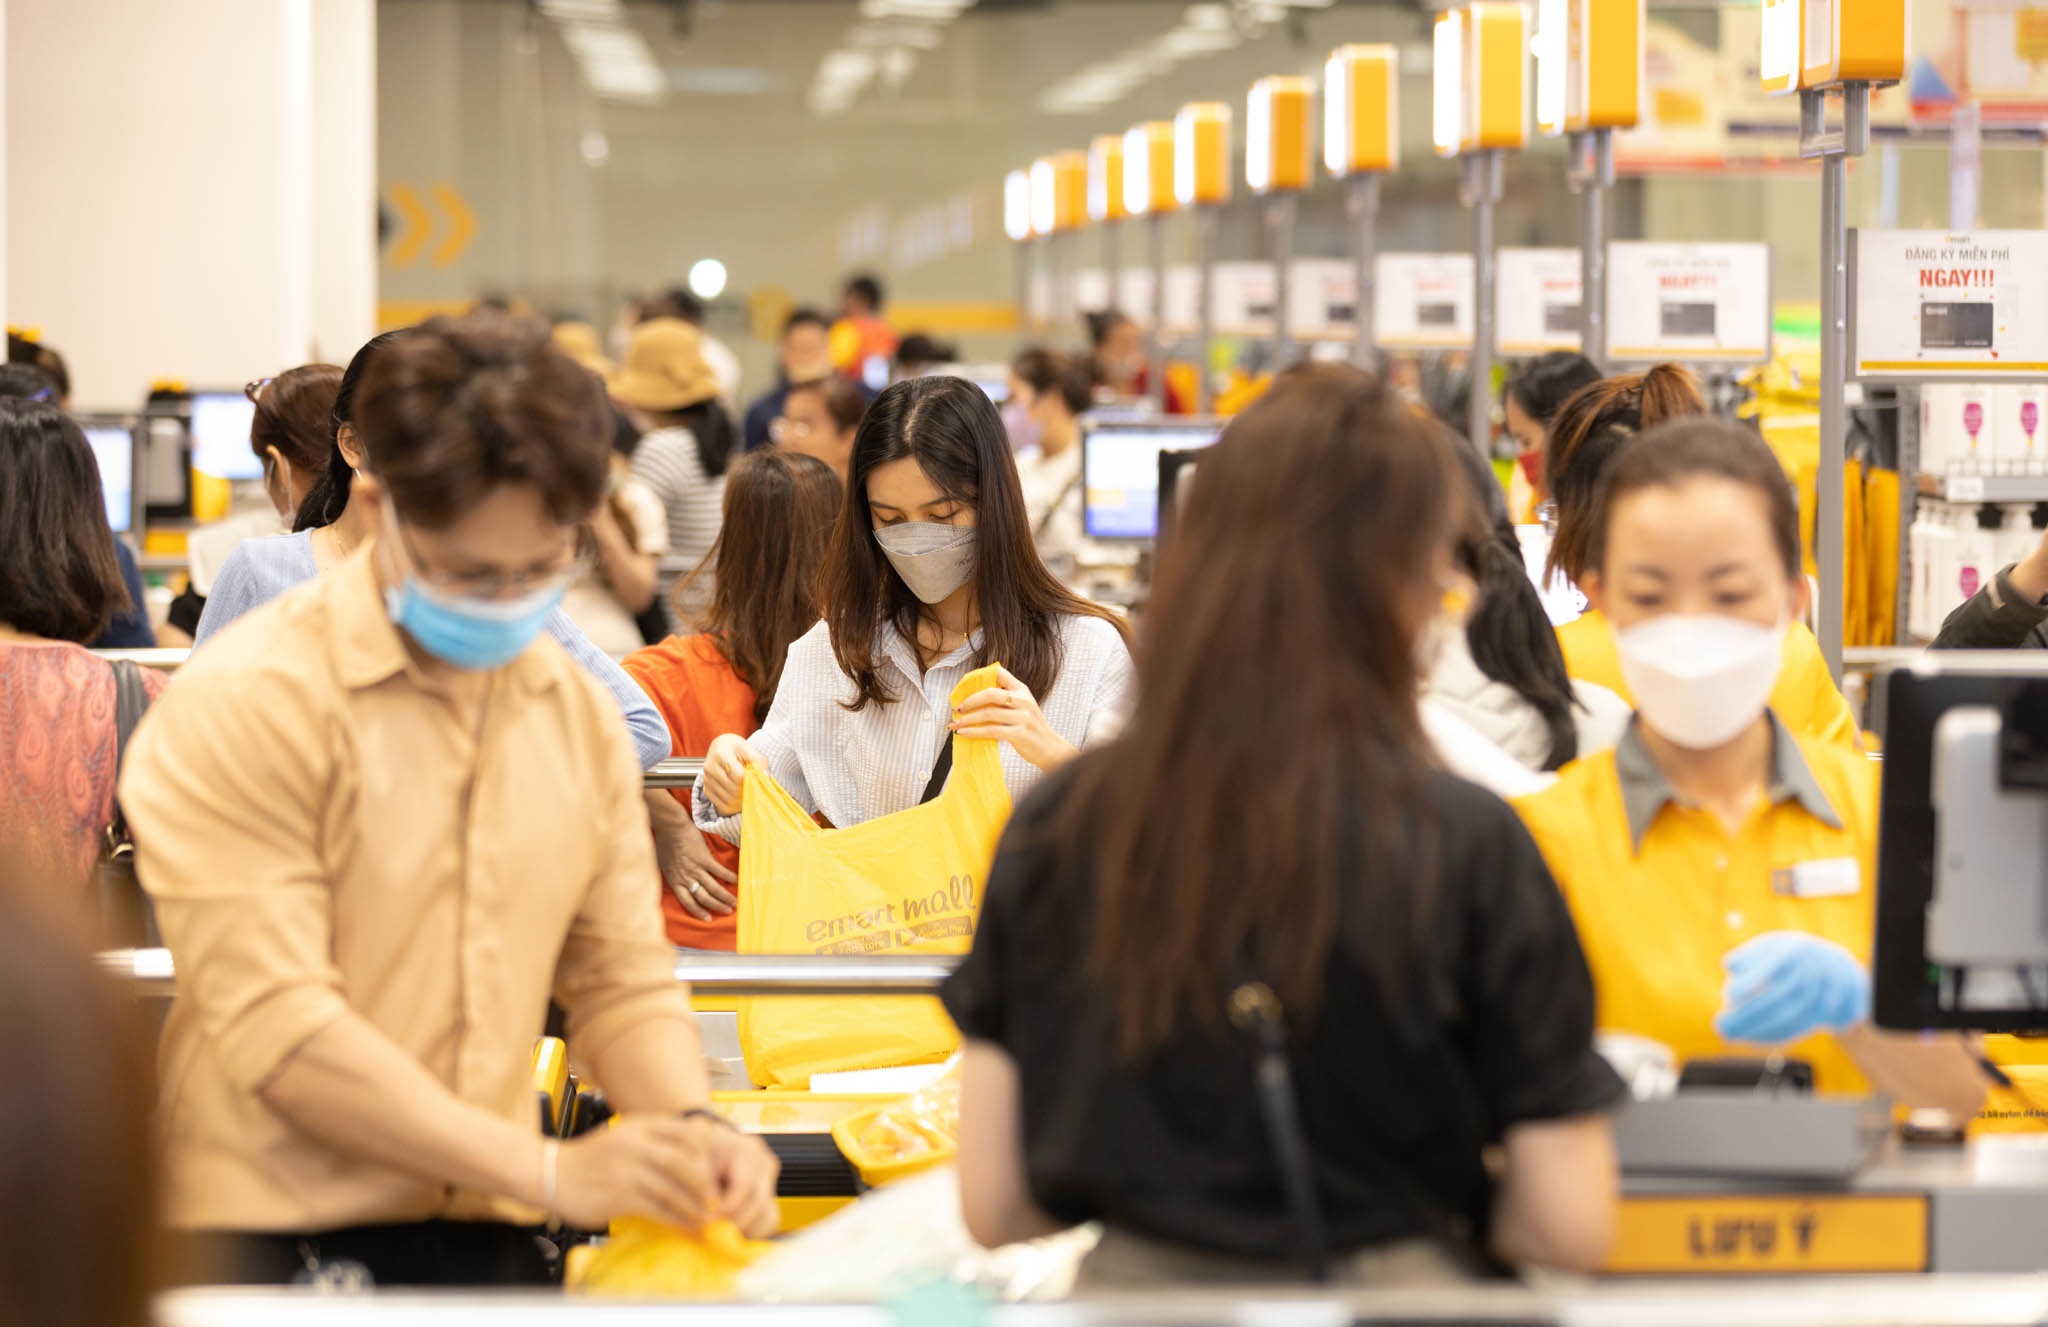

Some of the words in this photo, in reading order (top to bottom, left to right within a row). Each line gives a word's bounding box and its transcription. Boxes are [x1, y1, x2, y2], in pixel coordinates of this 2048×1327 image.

[1919, 269, 1995, 287] NGAY!!!
[806, 904, 896, 942] emart
[903, 874, 977, 921] mall
